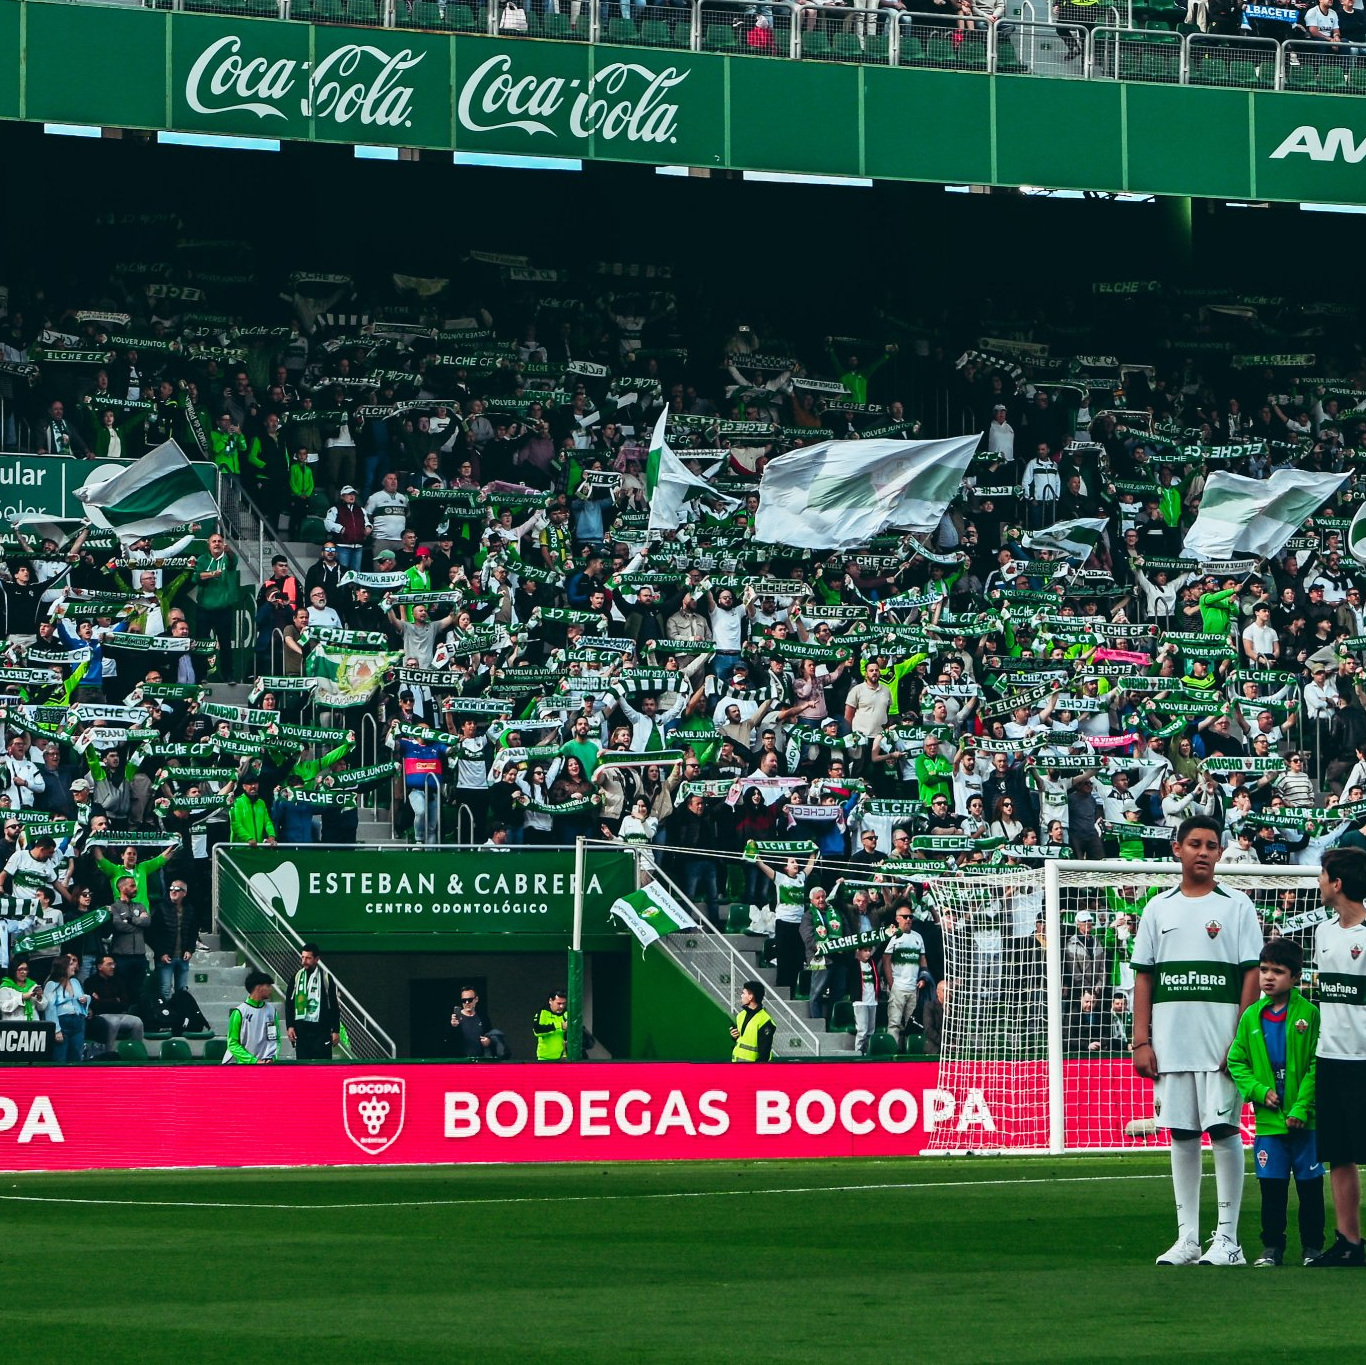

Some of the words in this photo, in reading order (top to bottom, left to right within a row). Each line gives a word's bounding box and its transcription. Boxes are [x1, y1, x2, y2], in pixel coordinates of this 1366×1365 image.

[1246, 5, 1297, 18] LBACETE
[806, 607, 843, 616] ELCHE
[845, 608, 861, 617] CF
[1095, 625, 1128, 635] ELCHE
[1131, 625, 1144, 635] CF
[399, 671, 441, 683] ELCHE
[444, 674, 459, 684] CF
[248, 711, 280, 724] ELCHE
[1207, 758, 1243, 771] MUCHO
[1255, 759, 1284, 771] ELCHE
[296, 791, 333, 804] ELCHE
[336, 794, 351, 805] CF
[309, 873, 437, 894] ESTEBAN
[449, 873, 463, 894] &
[365, 903, 409, 914] CENTRO
[417, 900, 548, 914] ODONTOLÓGICO
[349, 1084, 400, 1094] BOCOPA
[445, 1090, 729, 1137] BODEGAS
[756, 1089, 996, 1135] BOCOPA
